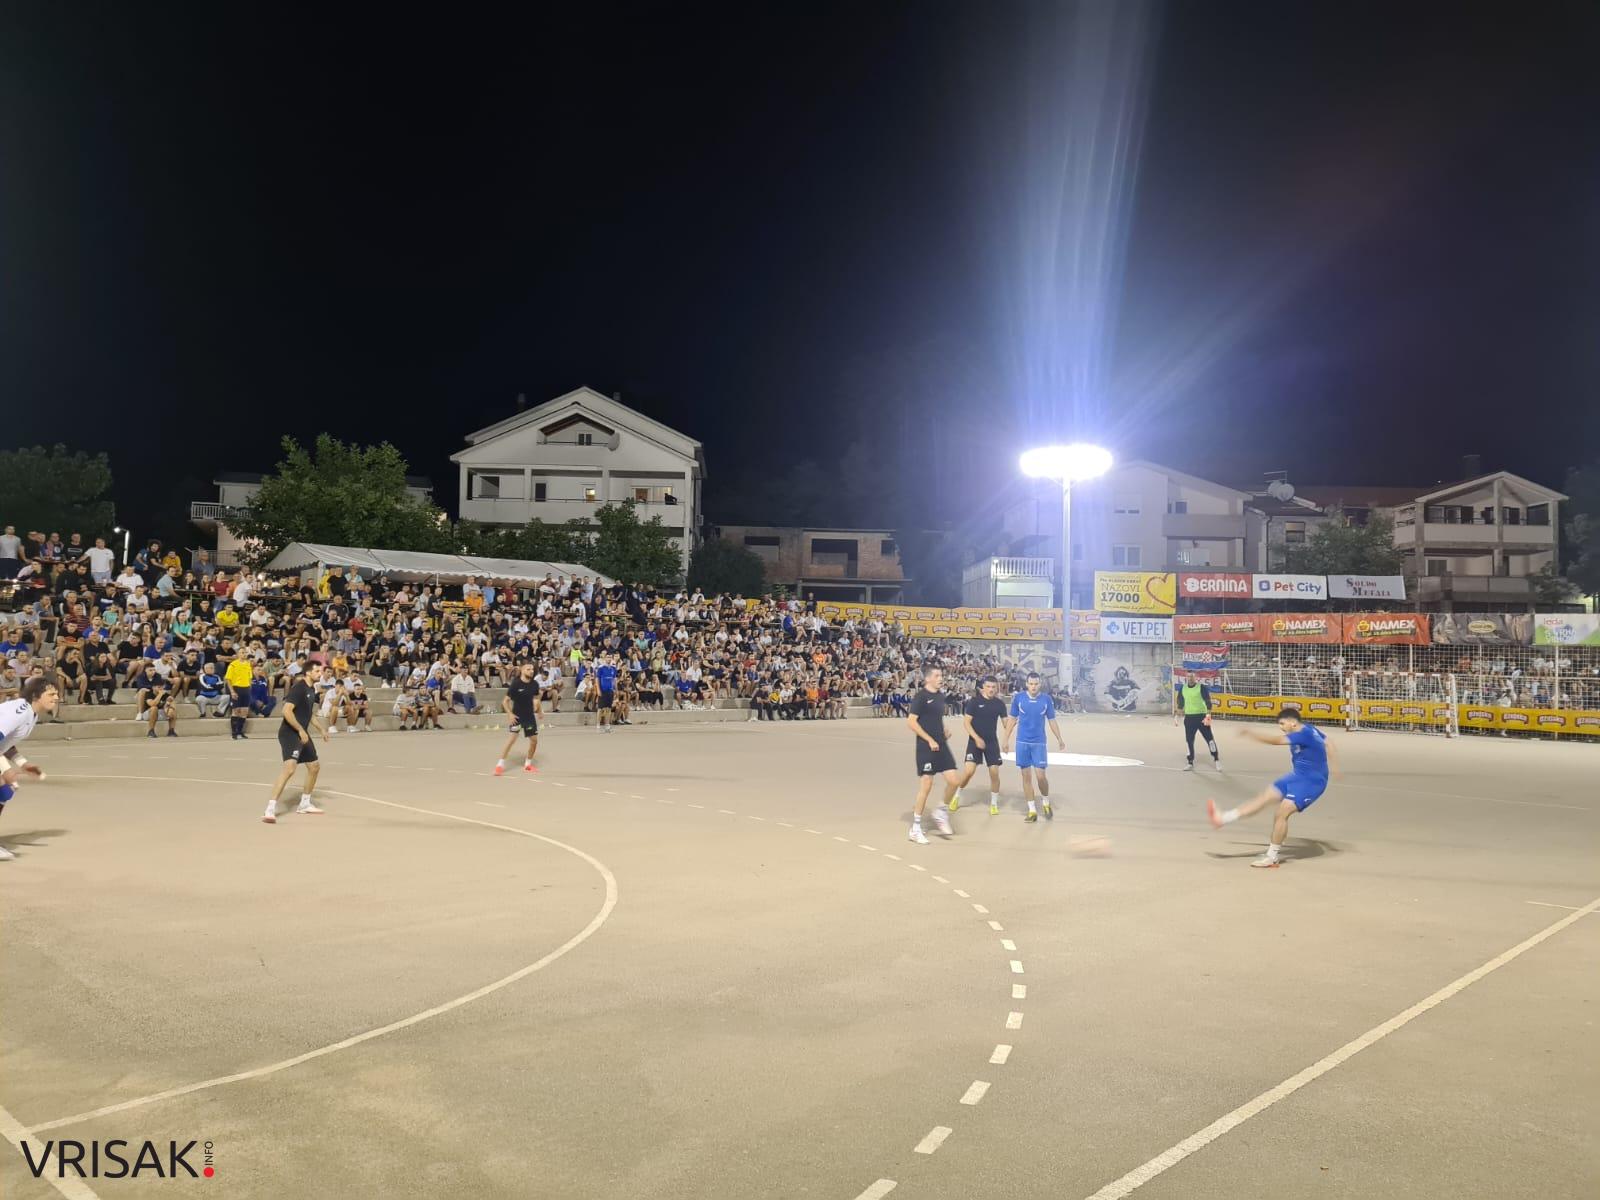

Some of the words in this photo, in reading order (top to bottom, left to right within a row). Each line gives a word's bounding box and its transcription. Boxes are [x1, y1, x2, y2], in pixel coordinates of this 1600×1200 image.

[1101, 583, 1140, 593] NAZOVI
[1184, 577, 1247, 593] BERNINA
[1274, 582, 1295, 592] Pet
[1297, 582, 1322, 594] City
[1101, 592, 1140, 603] 17000
[1123, 622, 1144, 635] VET
[1147, 622, 1167, 636] PET
[1286, 619, 1327, 630] NAMEX
[1370, 619, 1416, 631] NAMEX
